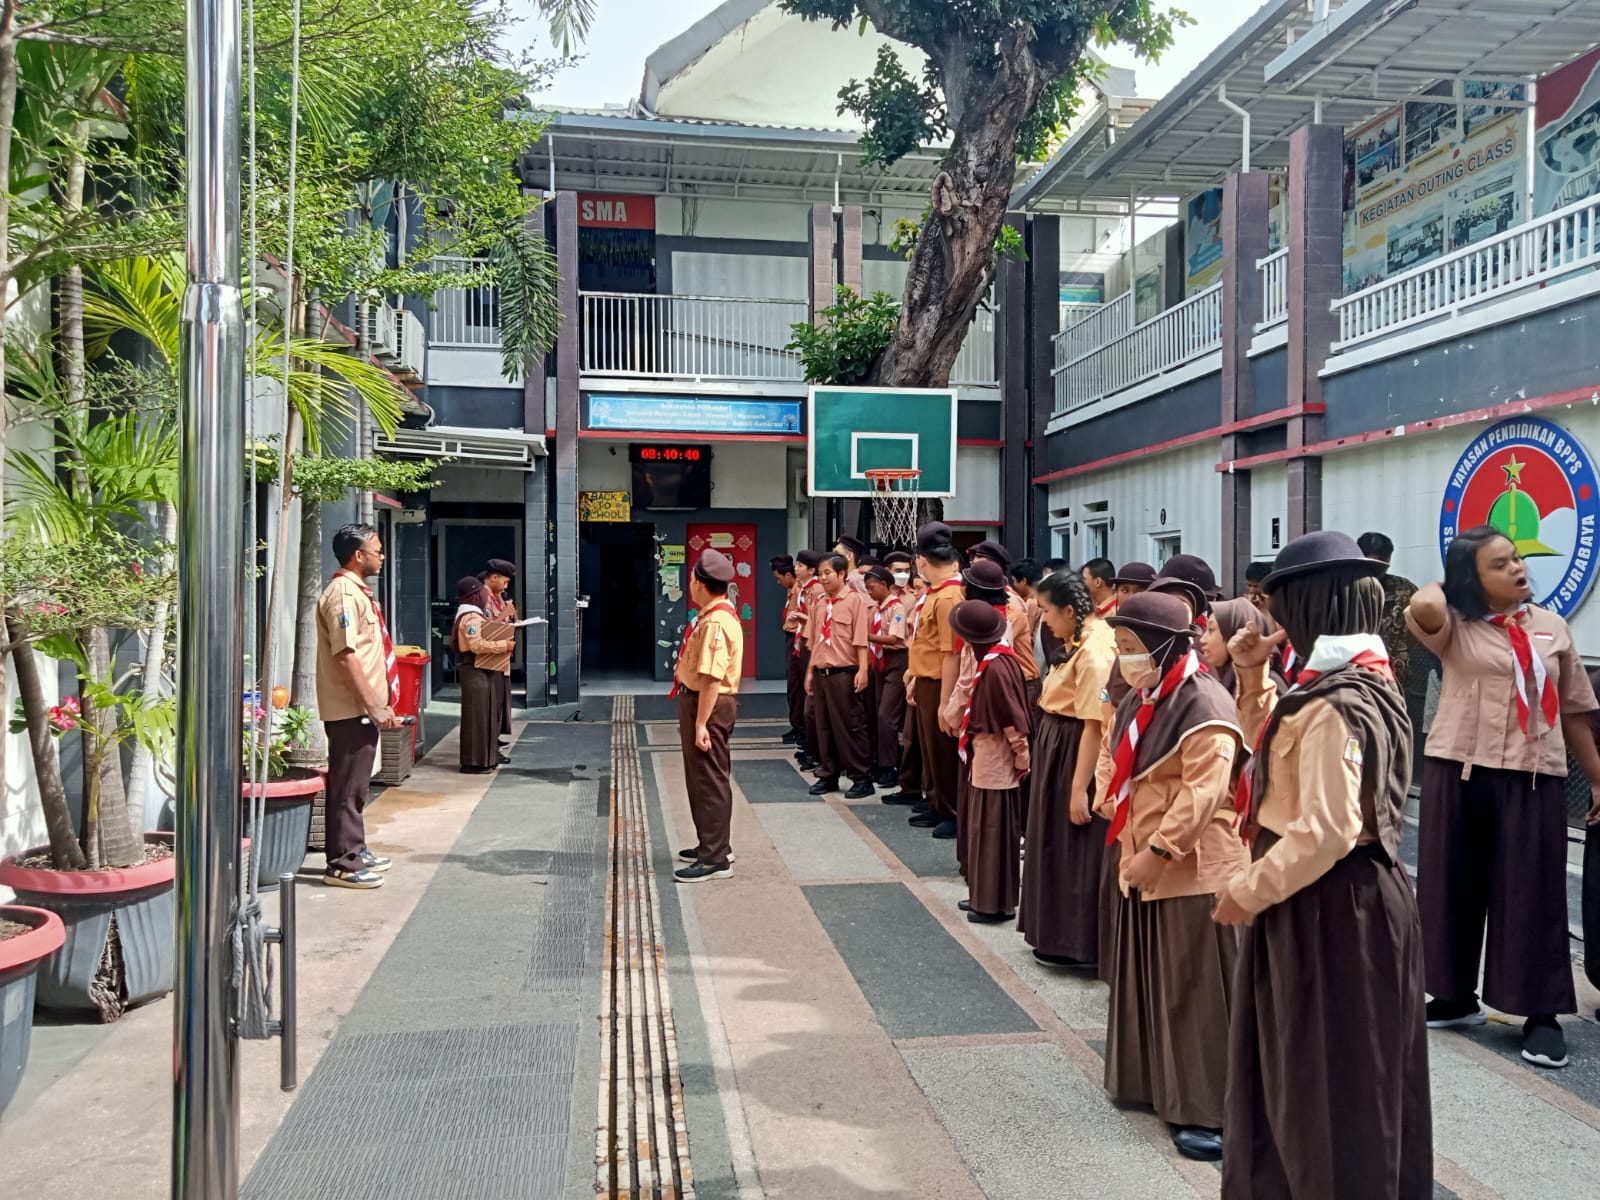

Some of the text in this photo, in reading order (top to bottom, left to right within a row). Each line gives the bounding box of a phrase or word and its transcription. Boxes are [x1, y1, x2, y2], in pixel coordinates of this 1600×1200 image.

[1362, 188, 1414, 224] KEGIATAN
[1418, 164, 1464, 195] OUTING
[1467, 138, 1513, 171] CLASS
[582, 200, 627, 222] SMA
[641, 448, 699, 460] 08:40:40
[1451, 423, 1582, 489] YAYASAN PENDIDIKAN BPPS
[592, 492, 616, 500] BACK
[597, 502, 611, 511] TO
[1559, 514, 1595, 601] SURABAYA
